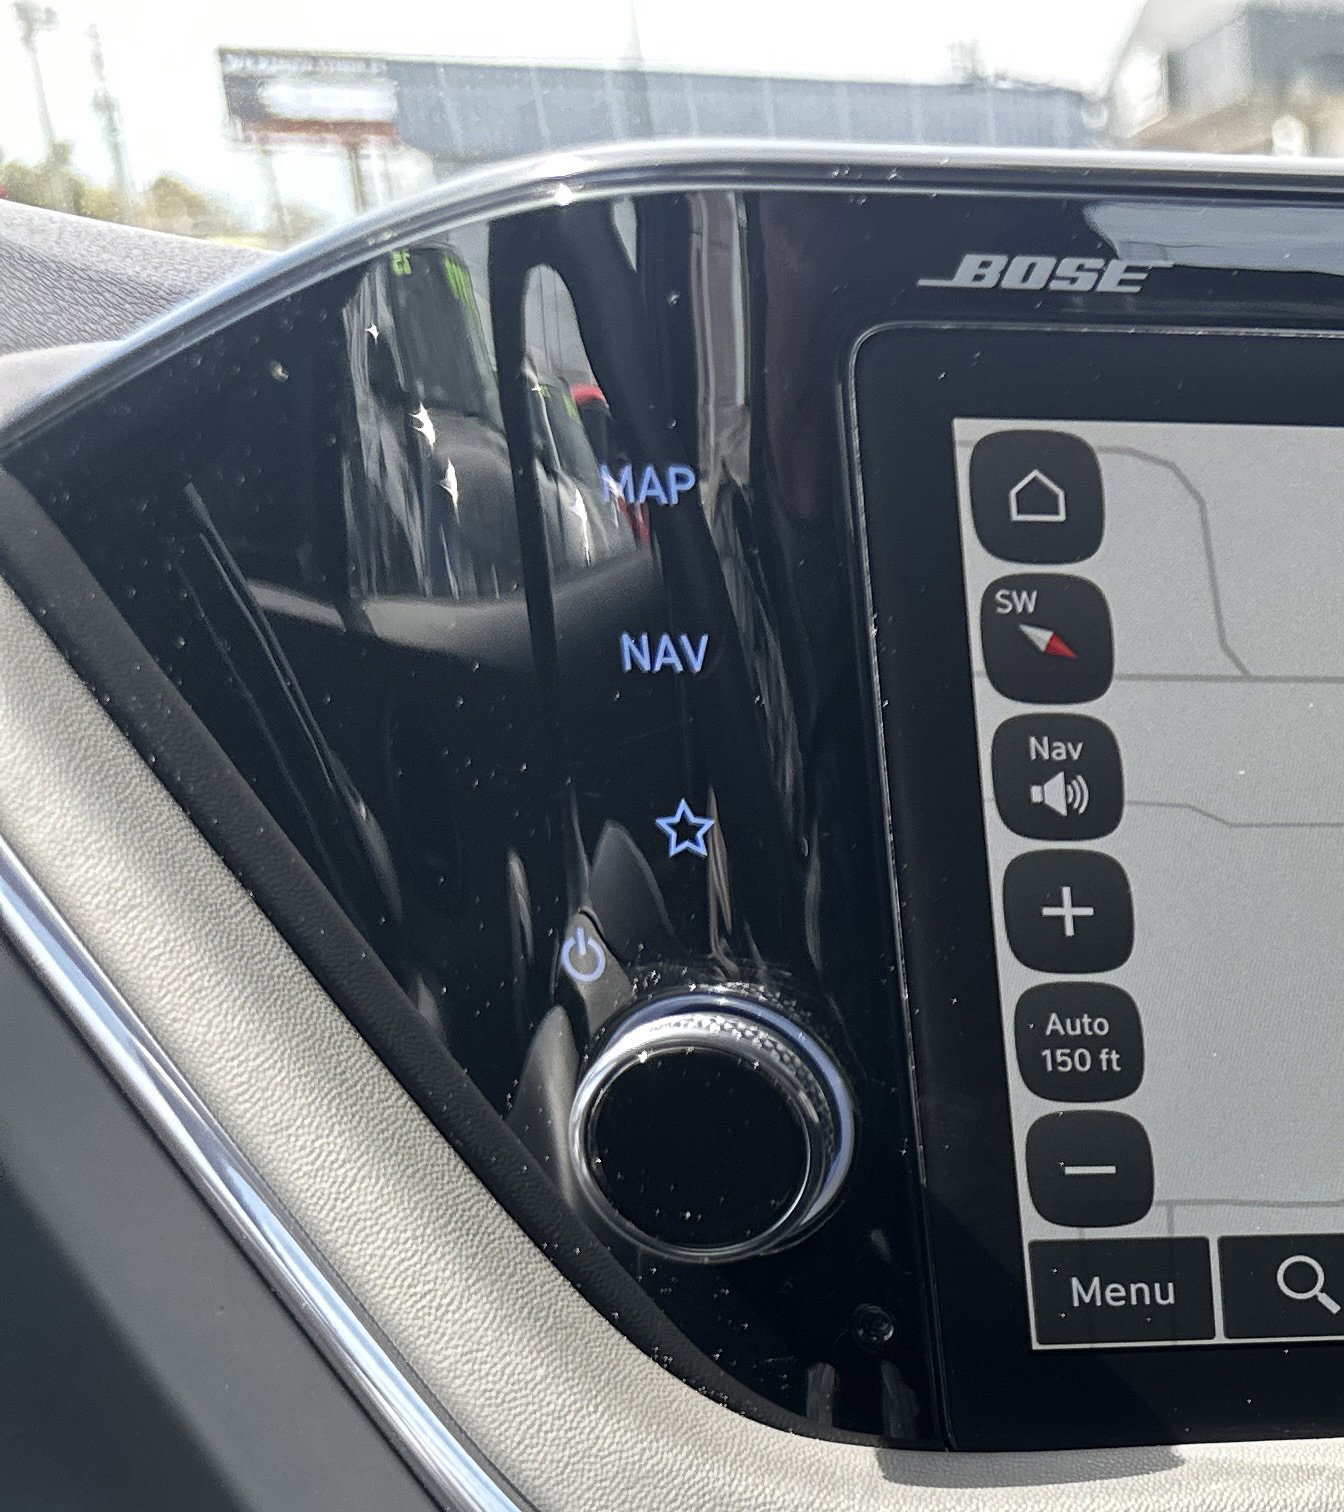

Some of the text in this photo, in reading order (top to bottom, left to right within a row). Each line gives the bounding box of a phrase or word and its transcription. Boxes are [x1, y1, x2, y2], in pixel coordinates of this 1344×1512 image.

[917, 254, 1149, 292] BOSE
[600, 463, 696, 505] MAP
[996, 590, 1037, 613] SW
[622, 633, 708, 672] NAV
[1030, 737, 1082, 760] Nav
[1046, 1013, 1109, 1035] Auto
[1042, 1049, 1120, 1071] 150 ft
[1072, 1277, 1174, 1306] Menu
